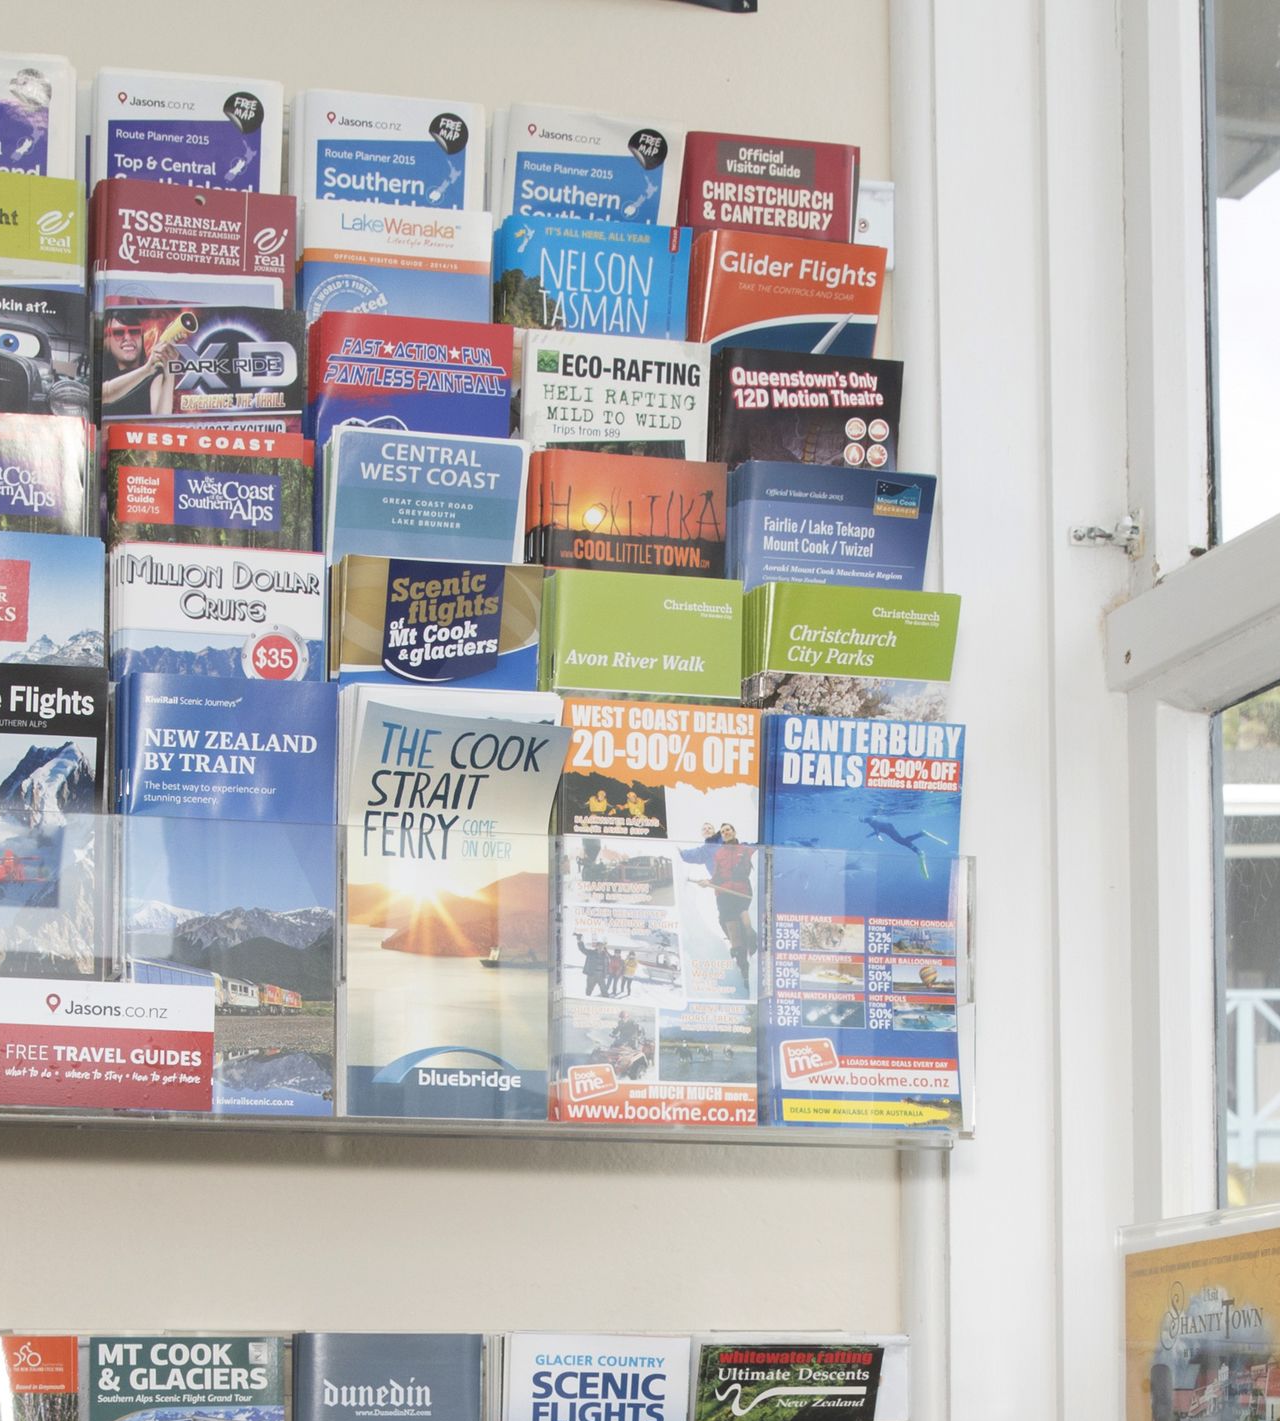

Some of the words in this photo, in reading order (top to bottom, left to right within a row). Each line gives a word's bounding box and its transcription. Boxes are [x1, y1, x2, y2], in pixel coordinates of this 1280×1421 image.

[702, 181, 833, 210] CHRISTCHURCH
[704, 201, 715, 218] &
[719, 203, 832, 230] CANTERBURY
[541, 250, 653, 297] NELSON
[721, 251, 793, 280] Glider
[799, 257, 877, 290] Flights
[541, 295, 646, 335] TASMAN
[562, 355, 700, 386] ECO-RAFTING
[565, 650, 607, 670] Avon
[611, 653, 657, 672] River
[660, 653, 705, 672] Walk
[10, 686, 94, 715] Flights
[571, 706, 624, 729] WEST
[629, 709, 689, 732] COAST
[694, 712, 754, 735] DEALS!
[144, 730, 199, 750] NEW
[205, 733, 317, 755] ZEALAND
[381, 723, 435, 769] THE
[451, 732, 549, 773] COOK
[783, 718, 961, 758] CANTERBURY
[144, 753, 173, 773] BY
[178, 755, 257, 775] TRAIN
[571, 731, 697, 772] 20-90%
[703, 732, 755, 775] OFF
[782, 753, 864, 788] DEALS
[366, 771, 490, 811] STRAIT
[363, 811, 460, 860] FERRY
[65, 999, 167, 1020] Jasons.co.nz
[6, 1044, 49, 1061] FREE
[54, 1045, 125, 1063] TRAVEL
[130, 1049, 202, 1066] GUIDES
[419, 1067, 521, 1090] bluebridge
[568, 1101, 756, 1123] www.bookme.co.nz
[98, 1344, 144, 1367] MT
[150, 1344, 233, 1366] COOK
[98, 1368, 120, 1391] &
[125, 1366, 267, 1391] GLACIERS
